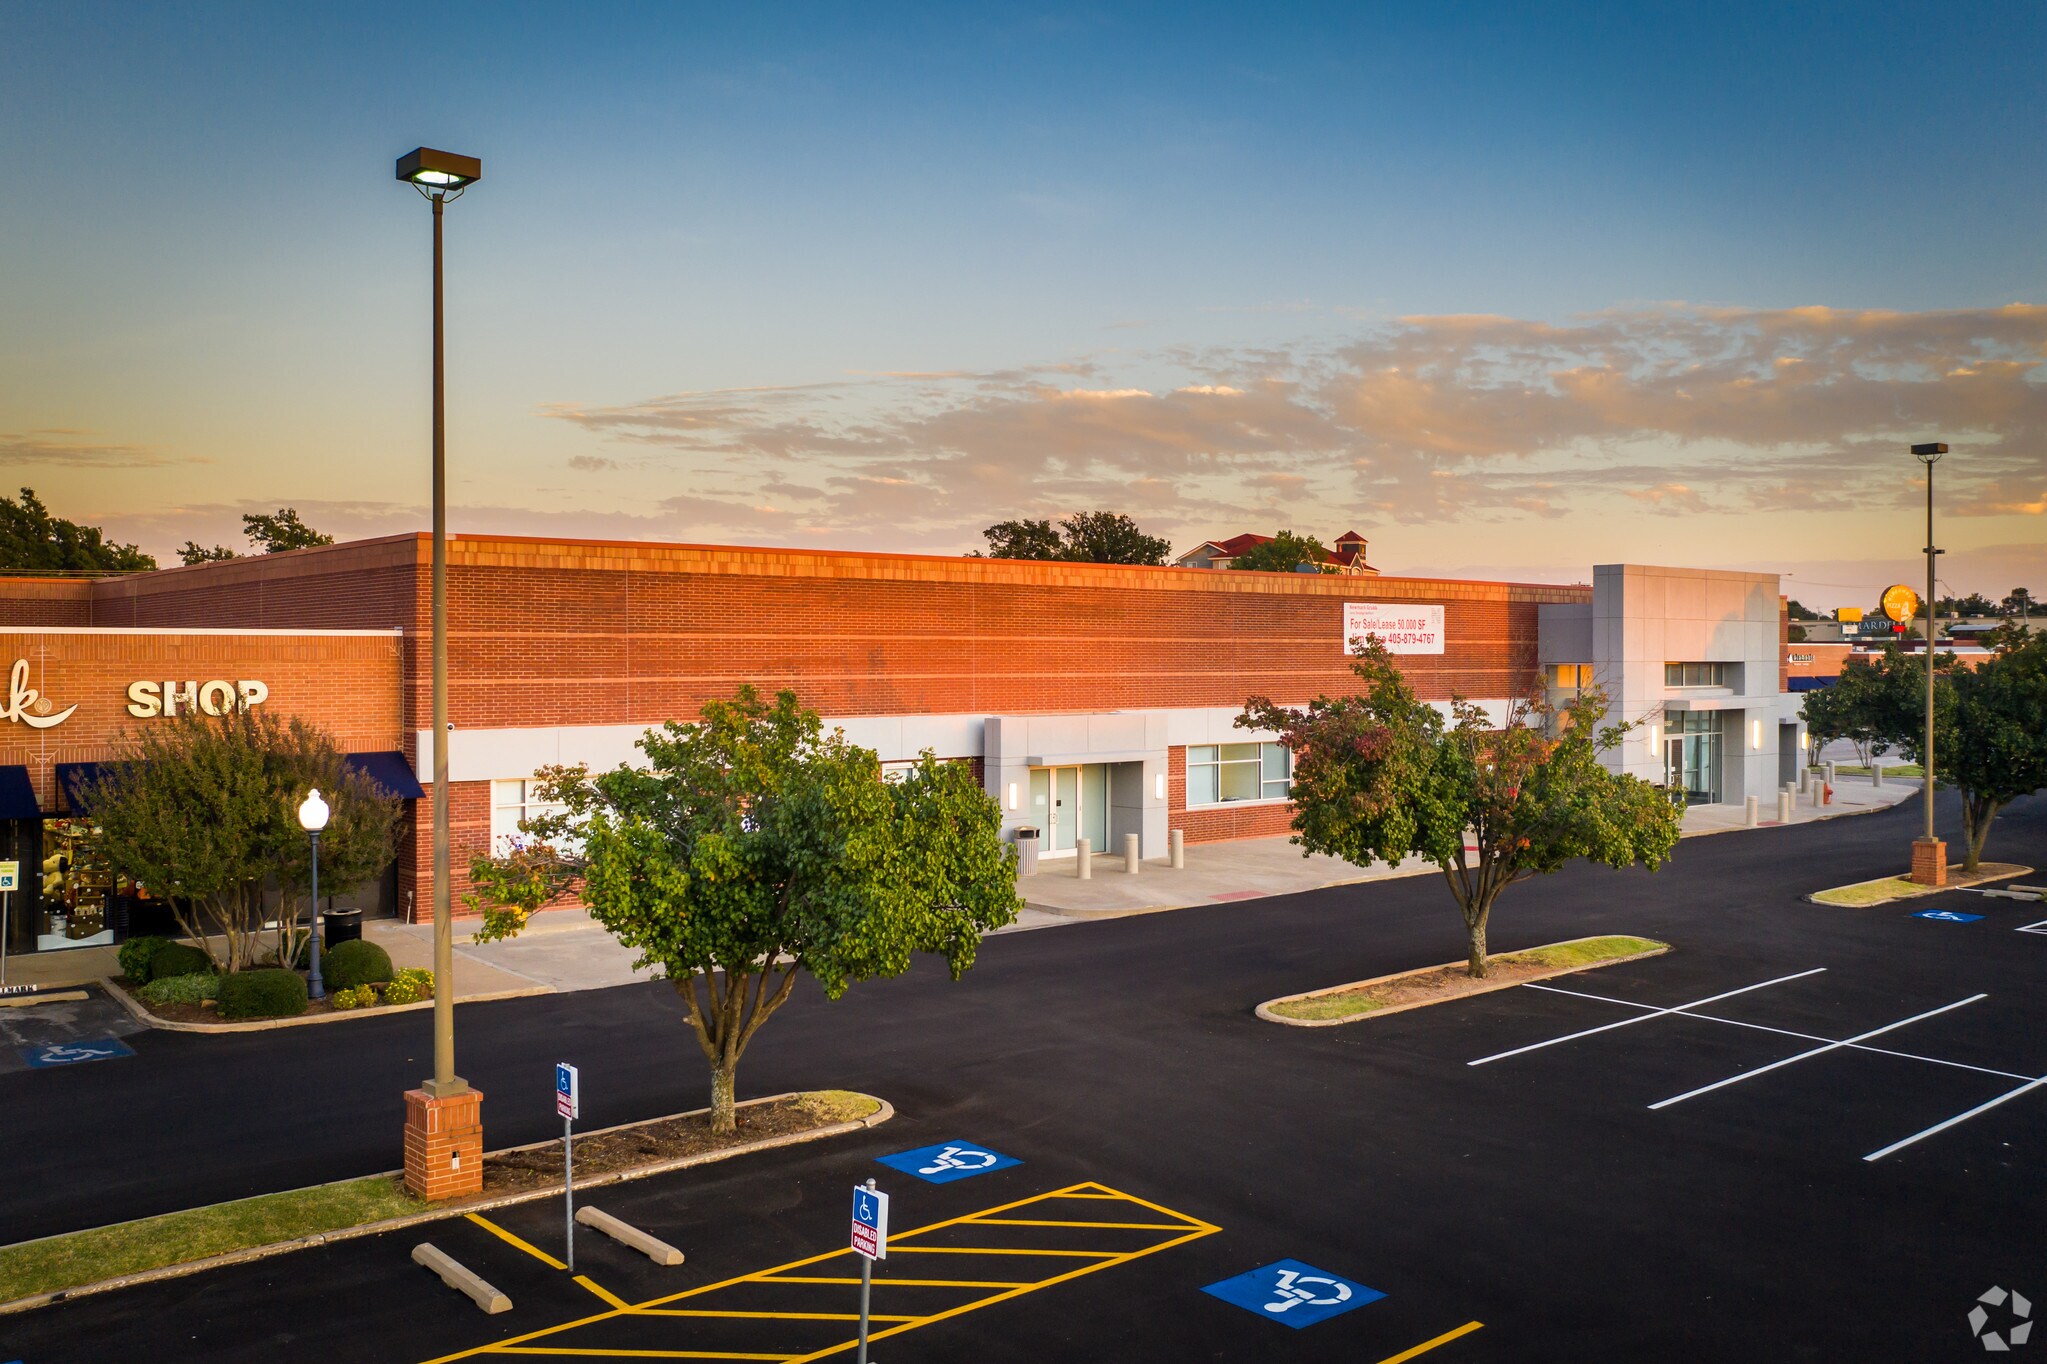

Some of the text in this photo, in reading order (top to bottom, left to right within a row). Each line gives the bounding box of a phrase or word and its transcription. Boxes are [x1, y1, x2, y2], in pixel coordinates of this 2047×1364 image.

[1350, 618, 1361, 630] For
[1417, 619, 1426, 630] SF
[1388, 633, 1435, 644] 405-879-4767
[128, 680, 269, 717] SHOP
[853, 1222, 877, 1242] DISABLED
[853, 1235, 876, 1254] PARKING
